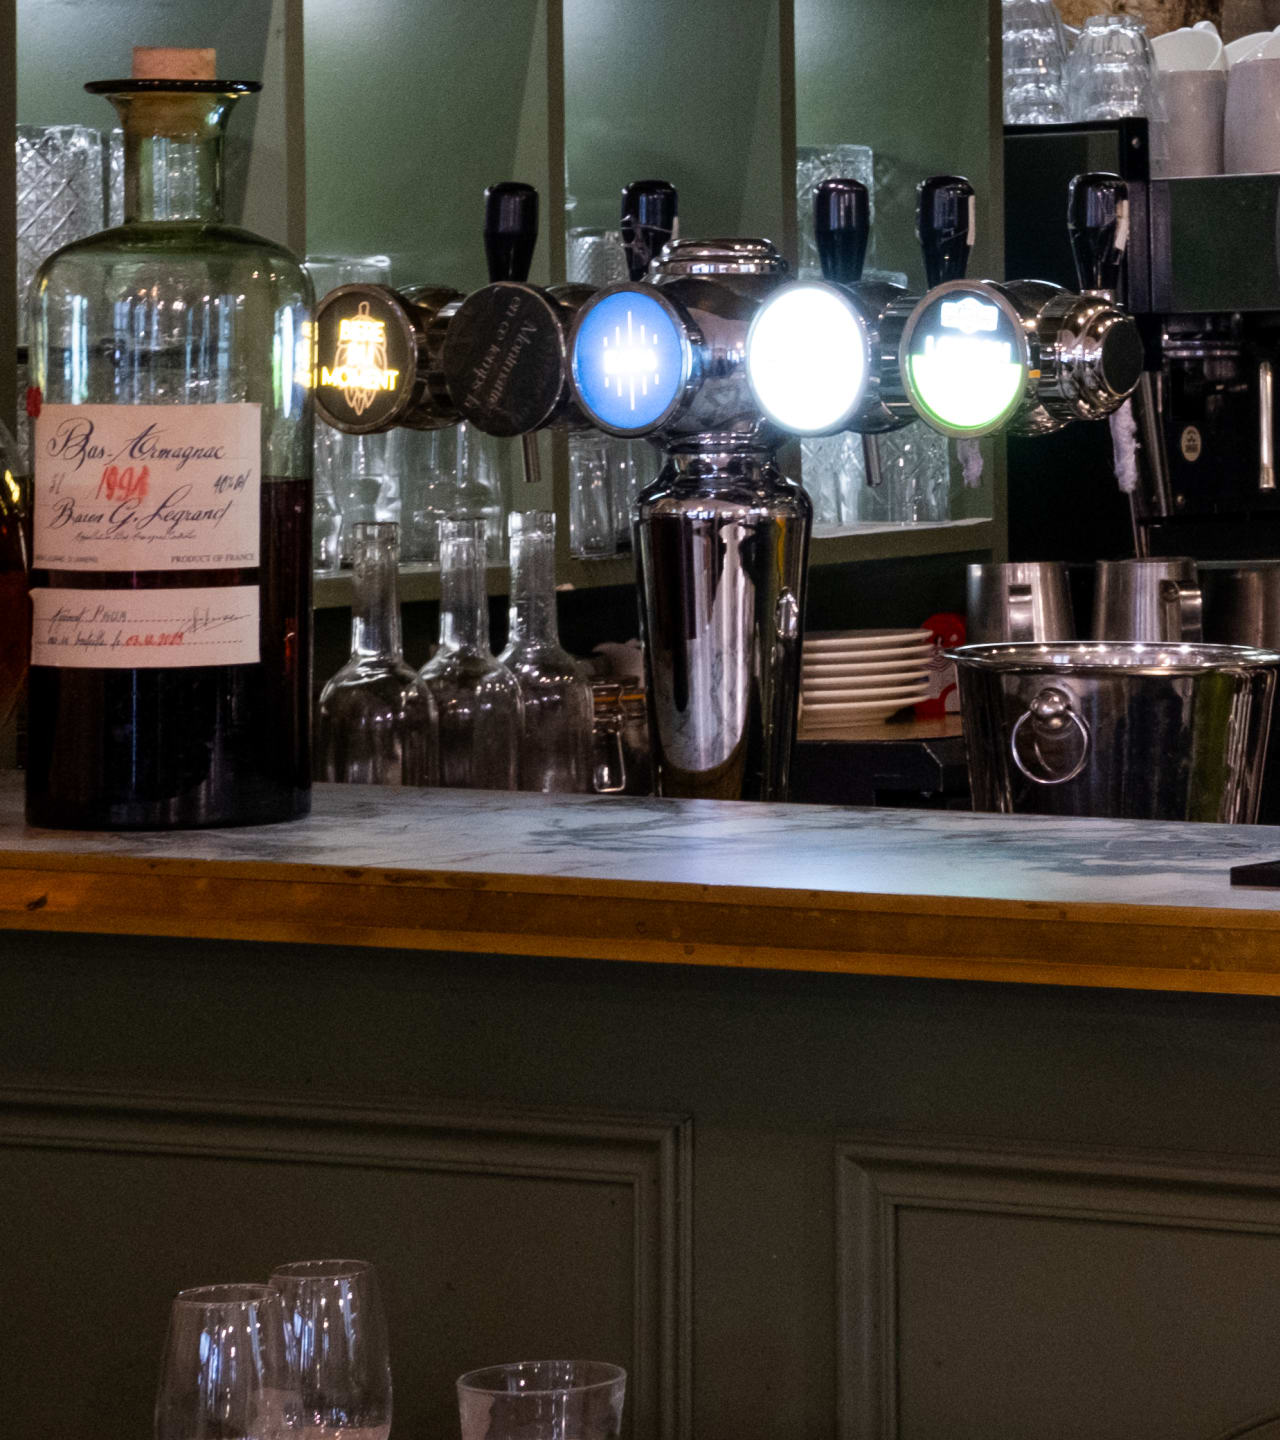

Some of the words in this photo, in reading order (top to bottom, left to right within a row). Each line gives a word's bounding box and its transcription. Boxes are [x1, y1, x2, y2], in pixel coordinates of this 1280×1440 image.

[321, 366, 399, 391] MOMENT
[137, 485, 233, 532] Legrand
[171, 555, 210, 563] PRODUCT
[225, 554, 256, 562] FRANCE
